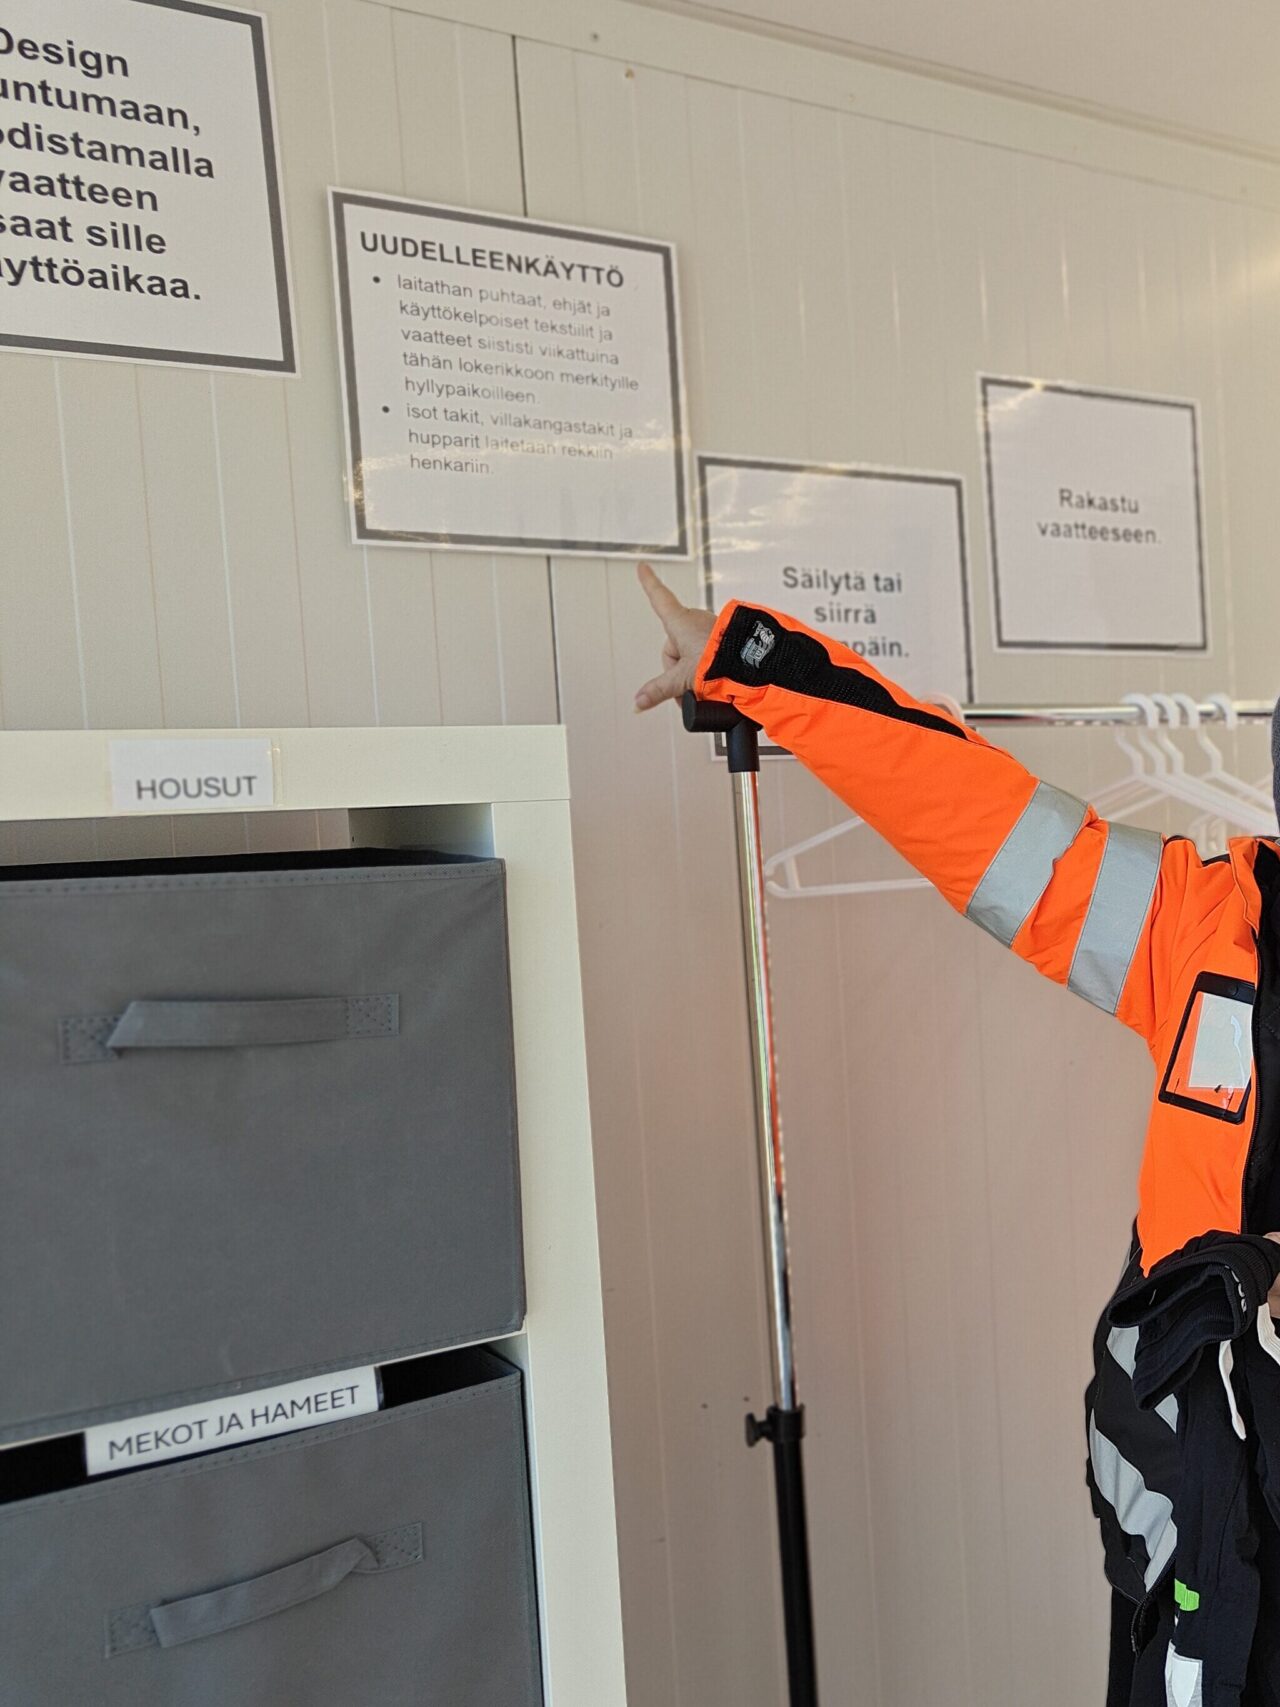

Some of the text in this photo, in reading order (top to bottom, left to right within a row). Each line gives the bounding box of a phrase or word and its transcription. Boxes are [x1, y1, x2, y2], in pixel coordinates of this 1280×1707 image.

[0, 121, 214, 179] distamalla
[0, 169, 158, 212] aatteen
[86, 221, 167, 254] sille
[0, 255, 201, 300] yttöaikaa.
[360, 231, 624, 288] UUDELLEENKÄYTTÖ
[398, 274, 611, 319] laitathan puhtaat, ehjät ja
[399, 300, 613, 343] käyttökelpoiset tekstiilit ja
[401, 329, 473, 348] vaatteet
[539, 344, 619, 365] viikattuina
[403, 352, 639, 392] tähän lokerikkoon merkityille
[406, 403, 633, 441] isot takit, villakangastakit ja
[408, 429, 480, 449] hupparit
[561, 443, 614, 459] rekkiin
[1059, 488, 1139, 514] Rakastu
[1036, 521, 1162, 544] vaatteeseen.
[783, 566, 902, 596] Säilytä tai
[814, 601, 877, 624] siirrä
[136, 775, 257, 800] HOUSUT
[108, 1385, 359, 1461] MEKOT JA HAMEET
